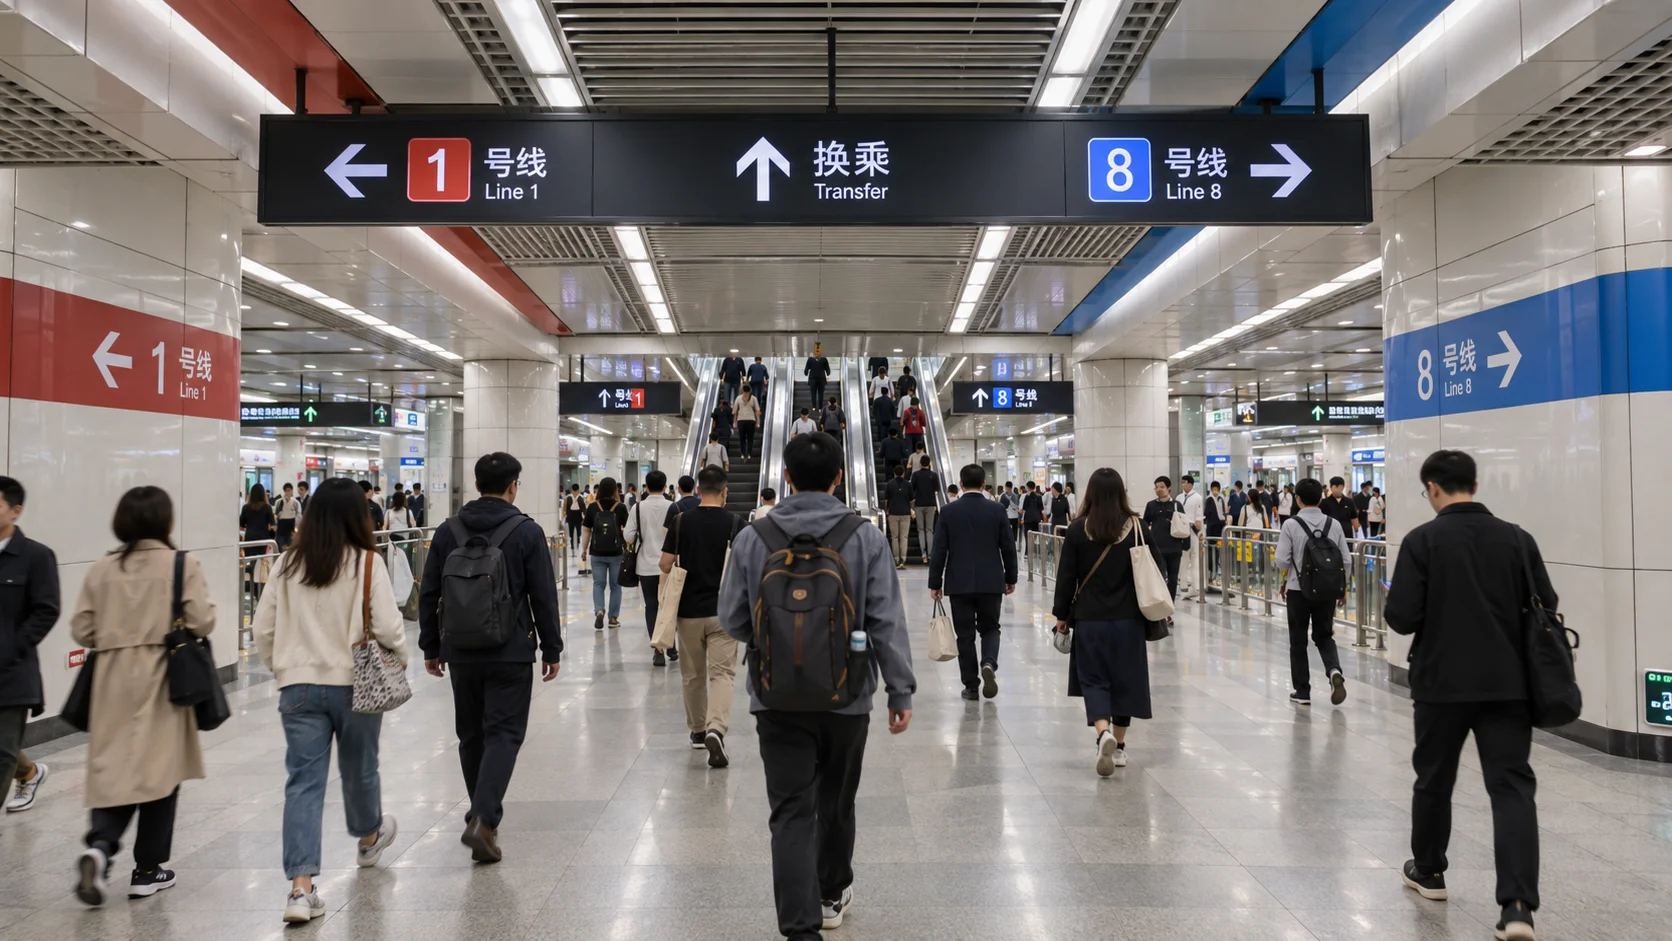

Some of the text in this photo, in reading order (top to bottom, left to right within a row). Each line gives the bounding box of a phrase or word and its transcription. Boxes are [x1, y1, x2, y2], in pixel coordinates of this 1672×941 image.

[813, 140, 889, 177] 换乘
[427, 147, 548, 192] 1 号线
[1106, 147, 1228, 193] 8 号线
[485, 182, 538, 200] Line 1
[814, 182, 889, 200] Transfer
[1166, 183, 1222, 200] Line 8
[151, 341, 212, 395] 1 号线
[1417, 338, 1477, 401] 8 号线
[180, 381, 206, 400] Line 1
[1444, 378, 1472, 397] Line 8
[635, 392, 641, 406] 1
[998, 390, 1008, 405] 8
